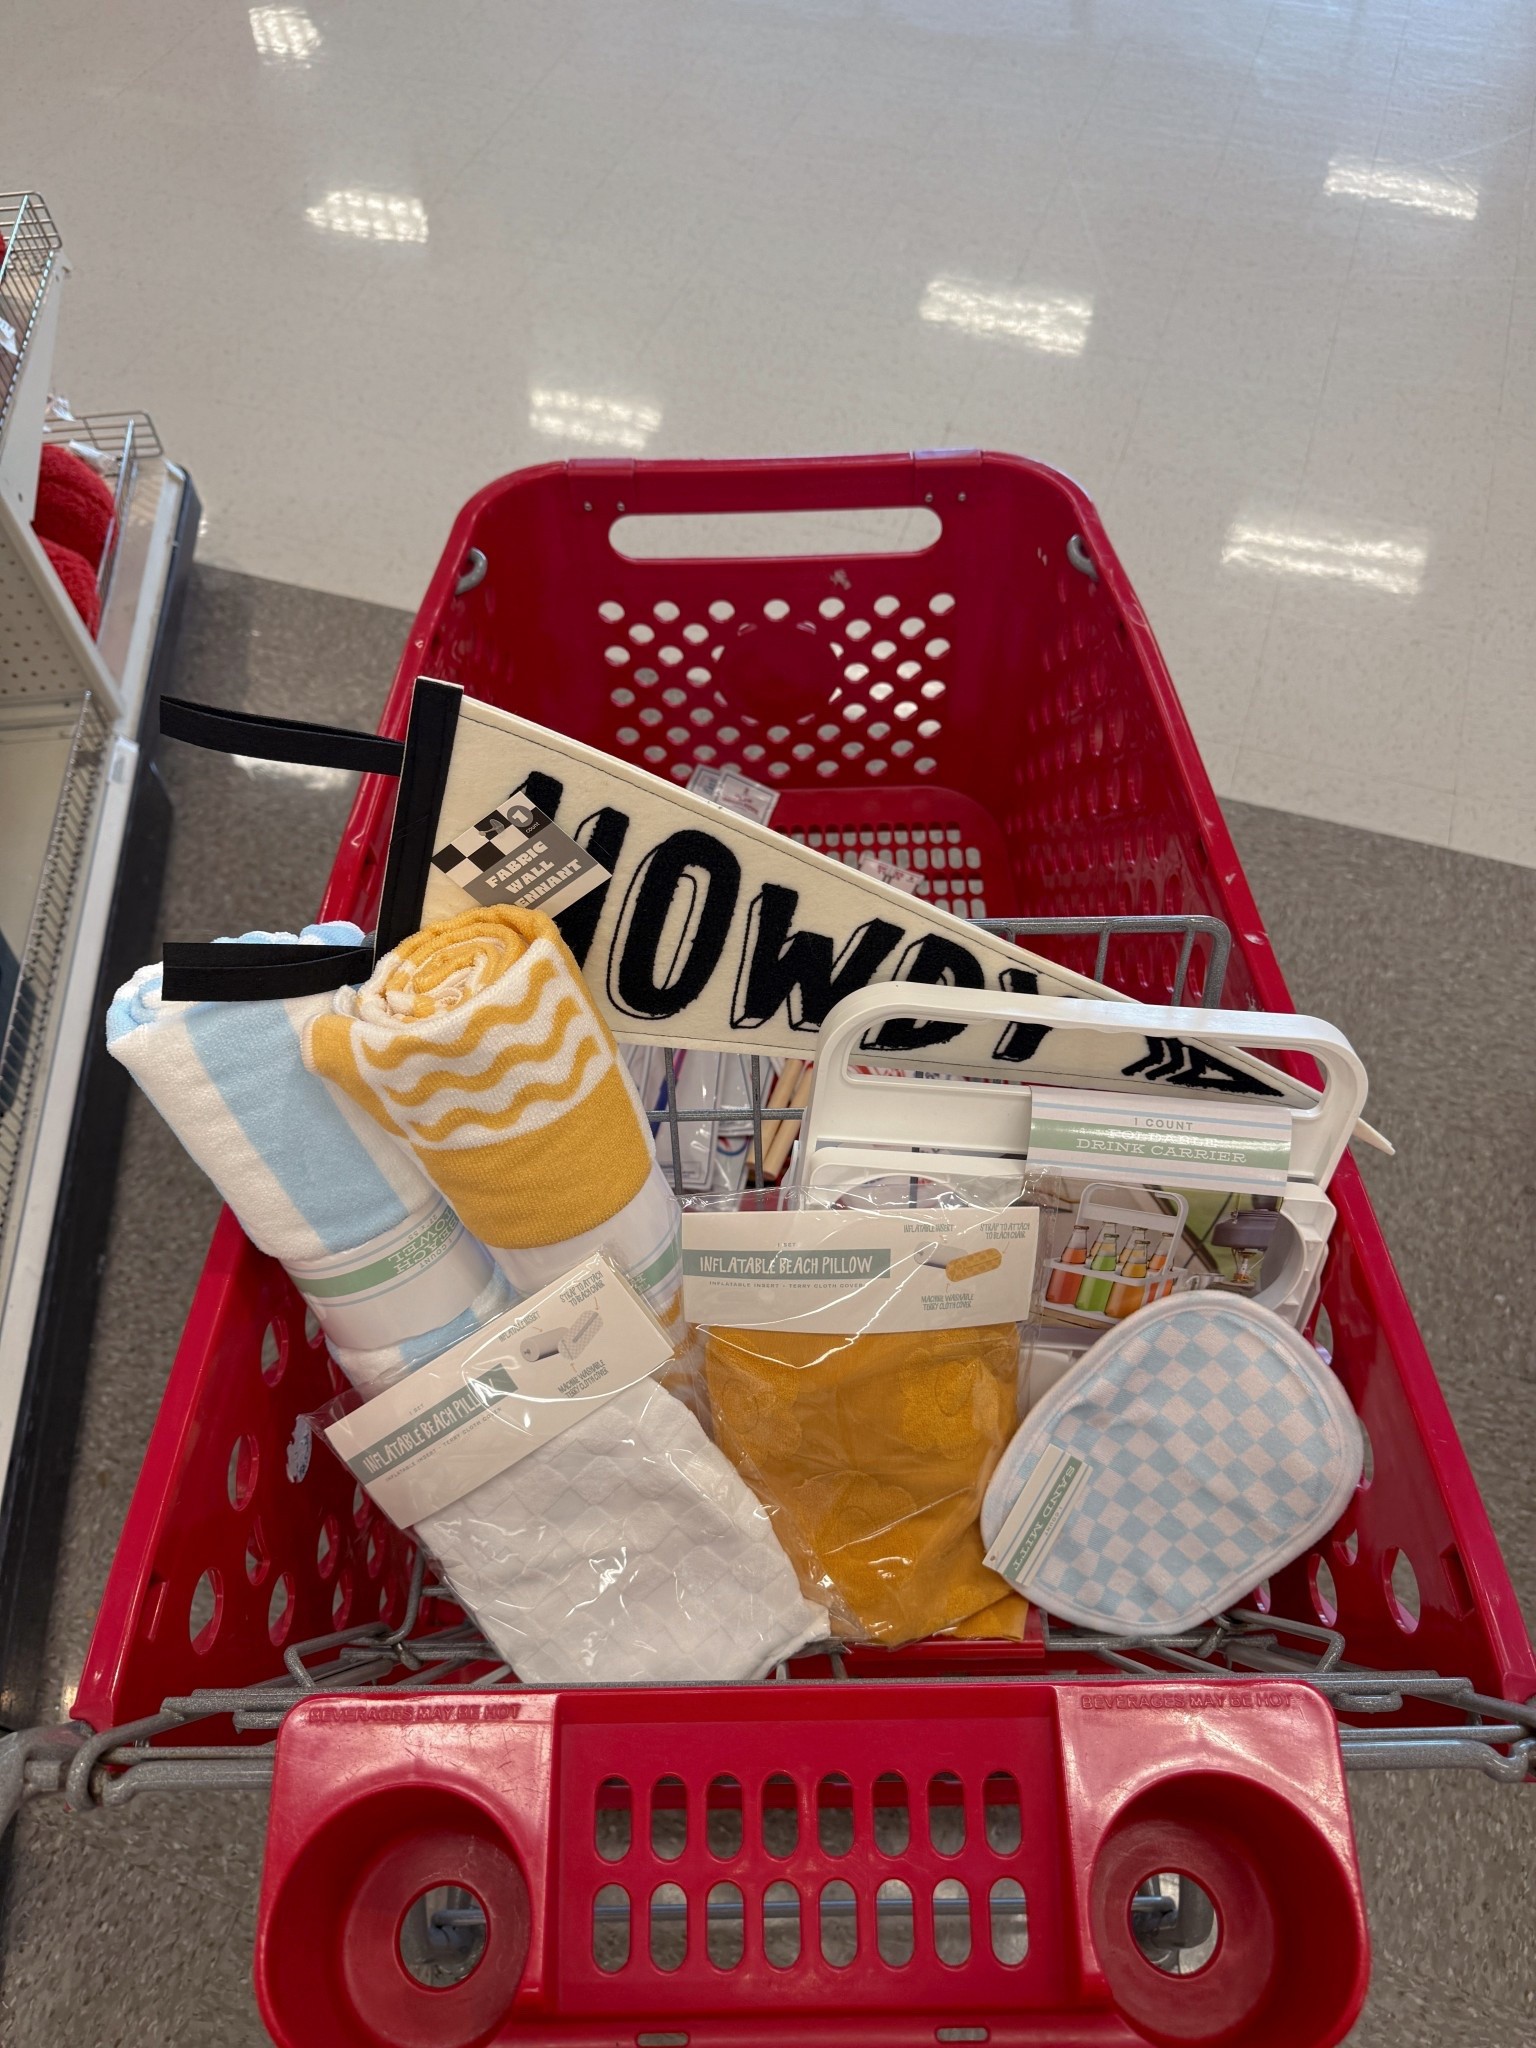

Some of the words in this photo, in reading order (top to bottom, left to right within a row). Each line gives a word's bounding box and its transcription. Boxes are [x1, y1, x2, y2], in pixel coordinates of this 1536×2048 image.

[511, 809, 529, 825] 1
[525, 821, 541, 834] count
[484, 840, 549, 889] FABRIC
[505, 859, 555, 895] WALL
[513, 858, 582, 908] ENNANT
[1145, 1118, 1193, 1131] COUNT
[1076, 1138, 1146, 1154] DRINK
[1150, 1145, 1247, 1164] CARRIER
[387, 1208, 453, 1263] TOWEL
[393, 1216, 459, 1274] BEACH
[420, 1244, 447, 1269] COUNT
[700, 1255, 776, 1274] INFLATABLE
[779, 1257, 818, 1274] BEACH
[822, 1255, 873, 1274] PILLOW
[362, 1427, 426, 1474] INFLATABLE
[420, 1406, 458, 1438] BEACH
[1042, 1465, 1076, 1518] SAND
[1012, 1521, 1043, 1571] MITT
[309, 1705, 413, 1723] BEVERAGES
[416, 1704, 455, 1720] MAY
[457, 1704, 481, 1721] BE
[483, 1703, 522, 1720] HOT
[1081, 1693, 1185, 1710] BEVERAGES
[1189, 1693, 1228, 1708] MAY
[1229, 1693, 1252, 1708] BE
[1254, 1692, 1293, 1707] HOT
